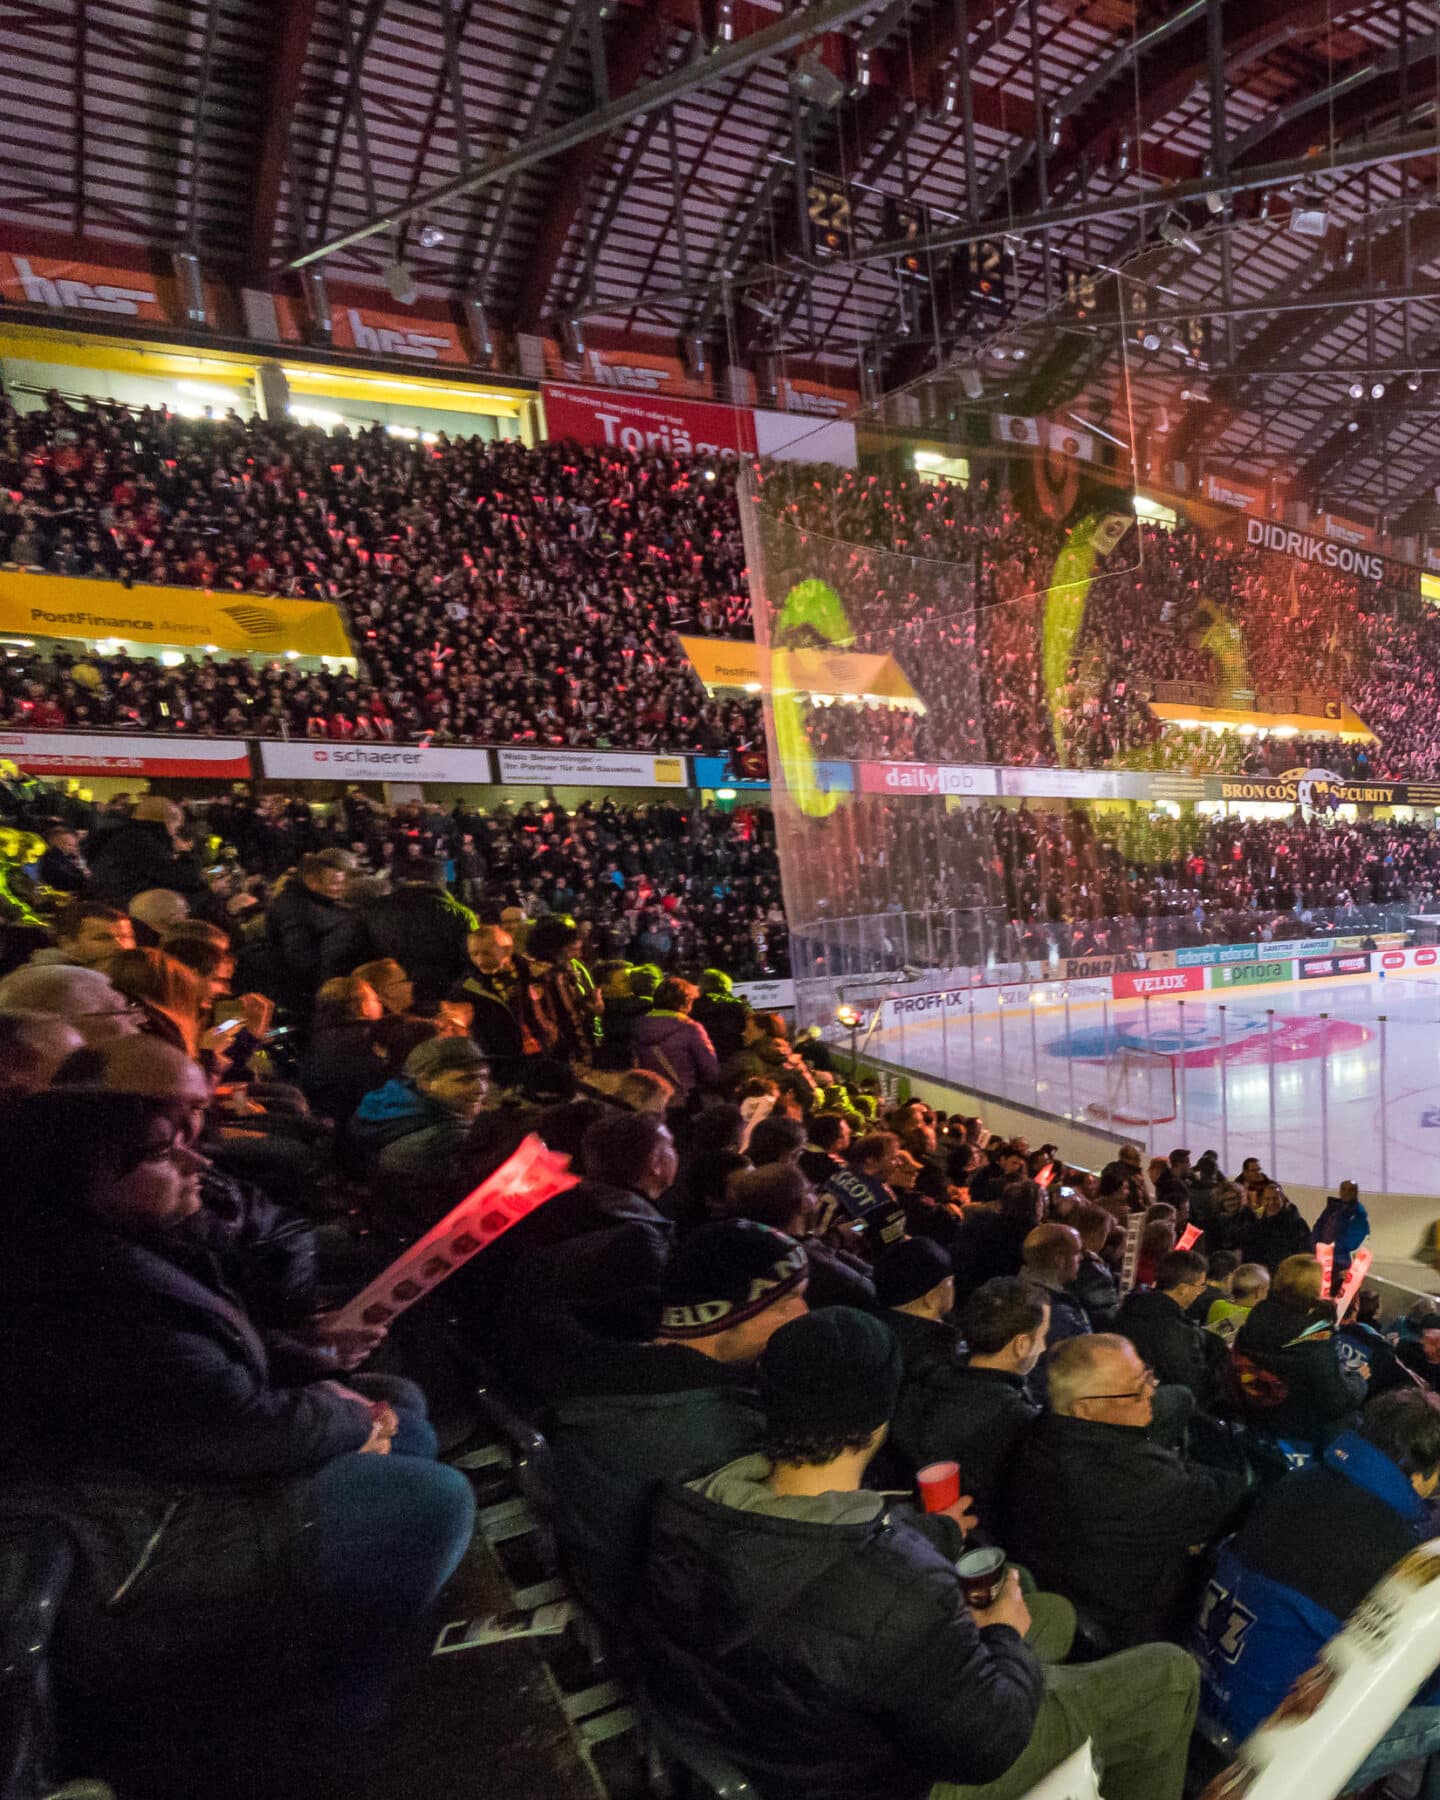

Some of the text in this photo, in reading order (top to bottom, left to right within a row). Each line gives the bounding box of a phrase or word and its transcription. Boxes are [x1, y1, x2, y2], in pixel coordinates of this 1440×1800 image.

[595, 413, 757, 458] Torjä
[1248, 519, 1383, 580] DIDRIKSONS
[31, 608, 154, 631] PostFinance
[333, 749, 424, 764] schaerer
[1330, 785, 1393, 801] SECURITY
[1133, 974, 1185, 992] VELUX
[1232, 963, 1281, 983] priora
